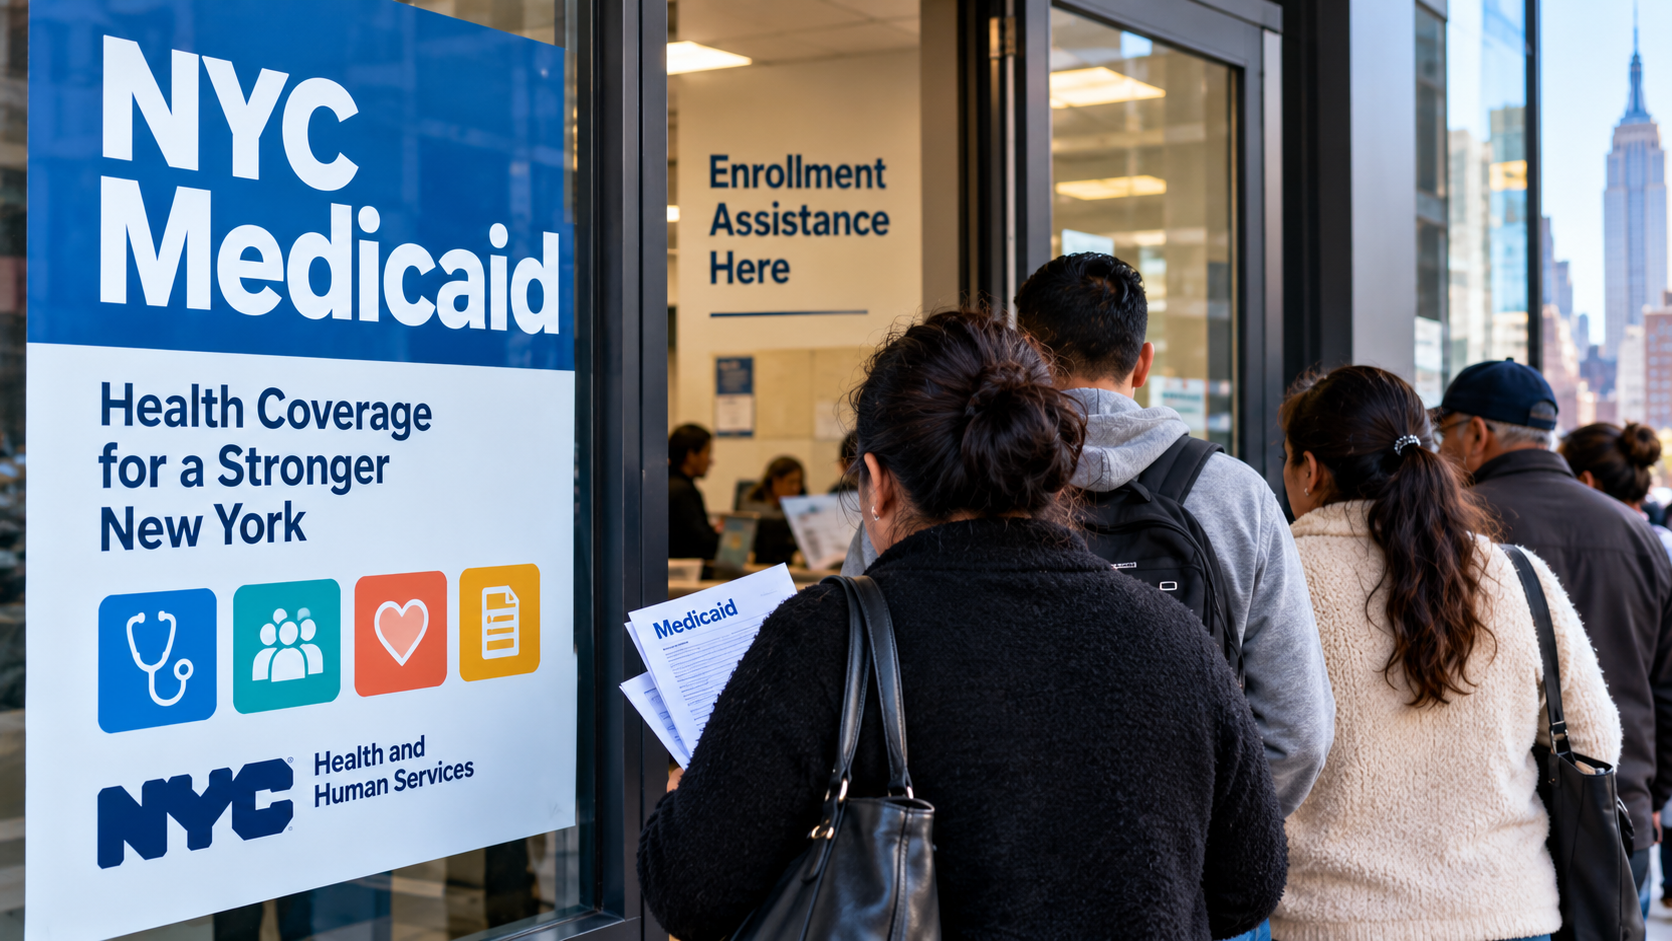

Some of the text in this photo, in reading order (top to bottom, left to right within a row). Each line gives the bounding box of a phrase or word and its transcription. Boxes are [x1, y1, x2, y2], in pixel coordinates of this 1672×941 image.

[102, 35, 359, 192] NYC
[709, 154, 887, 189] Enrollment
[709, 201, 890, 236] Assistance
[100, 175, 559, 335] Medicaid
[710, 251, 790, 285] Here
[101, 382, 432, 441] Health Coverage
[98, 442, 390, 495] for a Stronger
[100, 501, 307, 552] New York
[652, 598, 738, 640] Medicaid
[314, 735, 425, 776] Health and
[314, 757, 475, 808] Human Services
[97, 757, 294, 870] NYC
